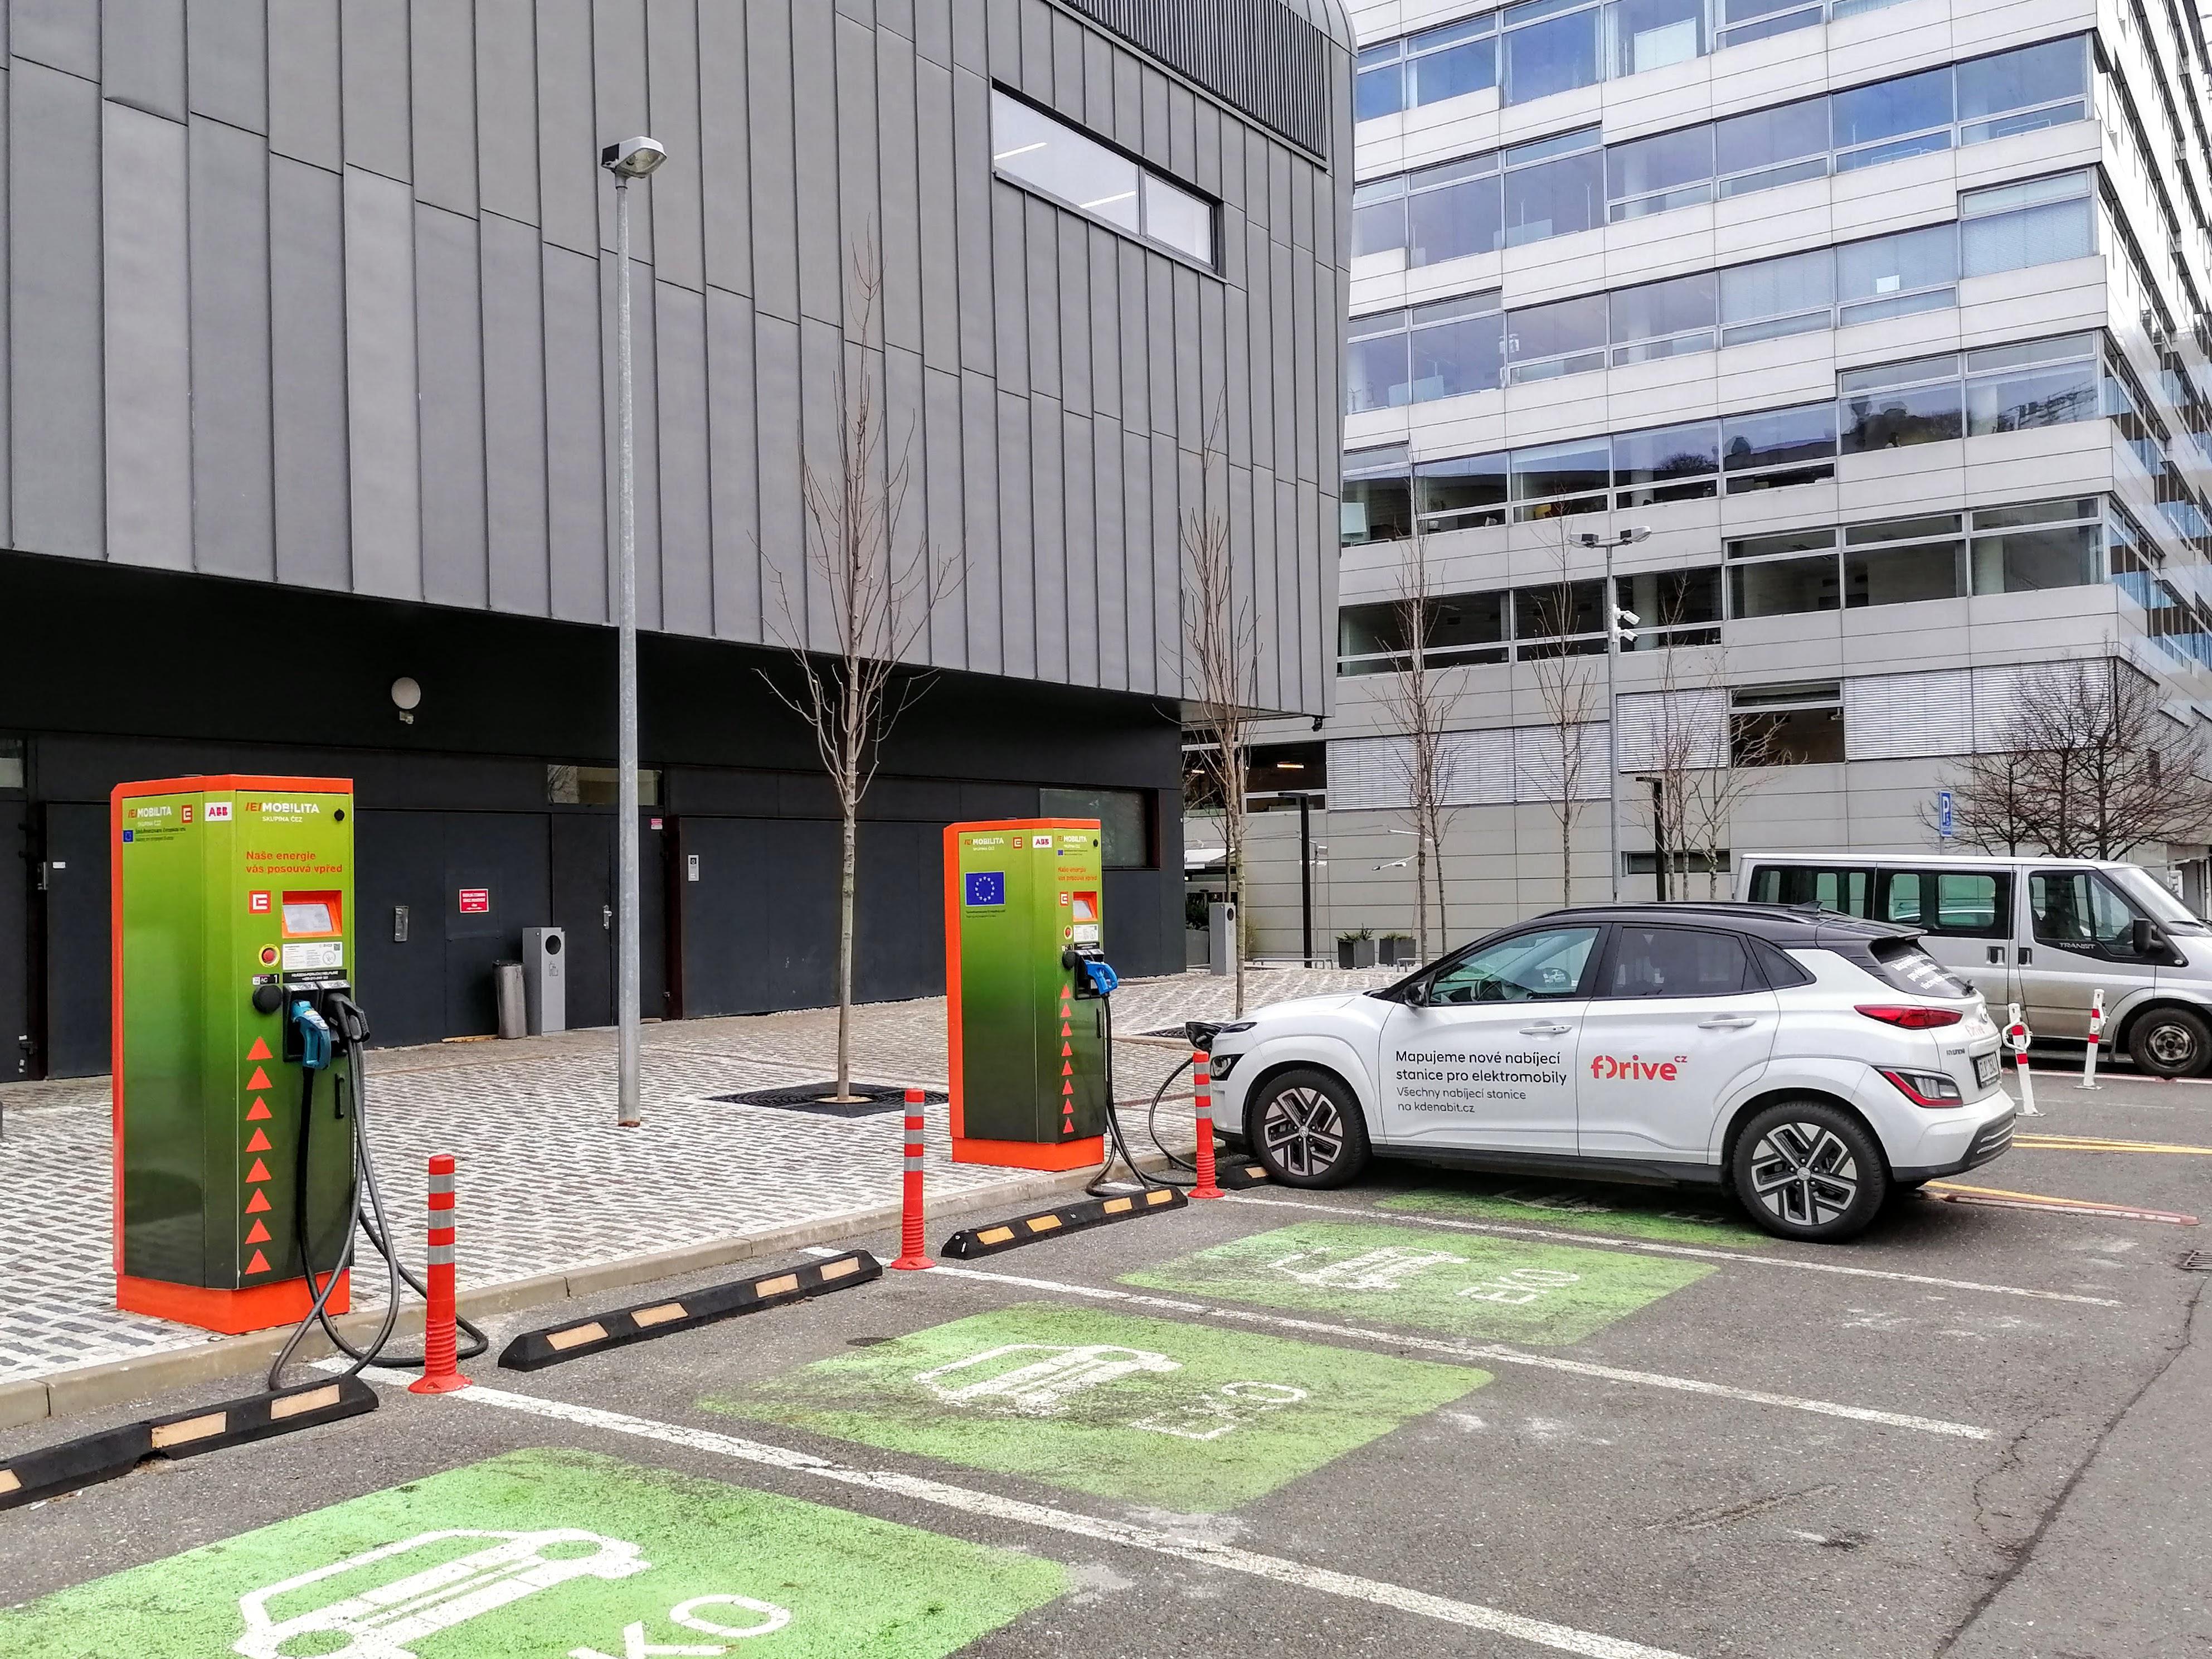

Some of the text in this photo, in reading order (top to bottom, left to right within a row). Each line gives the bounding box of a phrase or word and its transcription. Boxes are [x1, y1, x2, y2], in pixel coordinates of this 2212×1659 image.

[208, 806, 228, 817] ABB
[1942, 796, 1950, 823] P
[246, 851, 315, 861] Naše energie
[246, 864, 343, 874] vás posouvá vpřed
[1396, 1050, 1561, 1066] Mapujeme nové nabíjecí
[1396, 1069, 1567, 1085] stanice pro elektromobily
[1397, 1086, 1526, 1102] Všechny nabíjecí stanice
[1398, 1102, 1475, 1113] na kdenabit.cz
